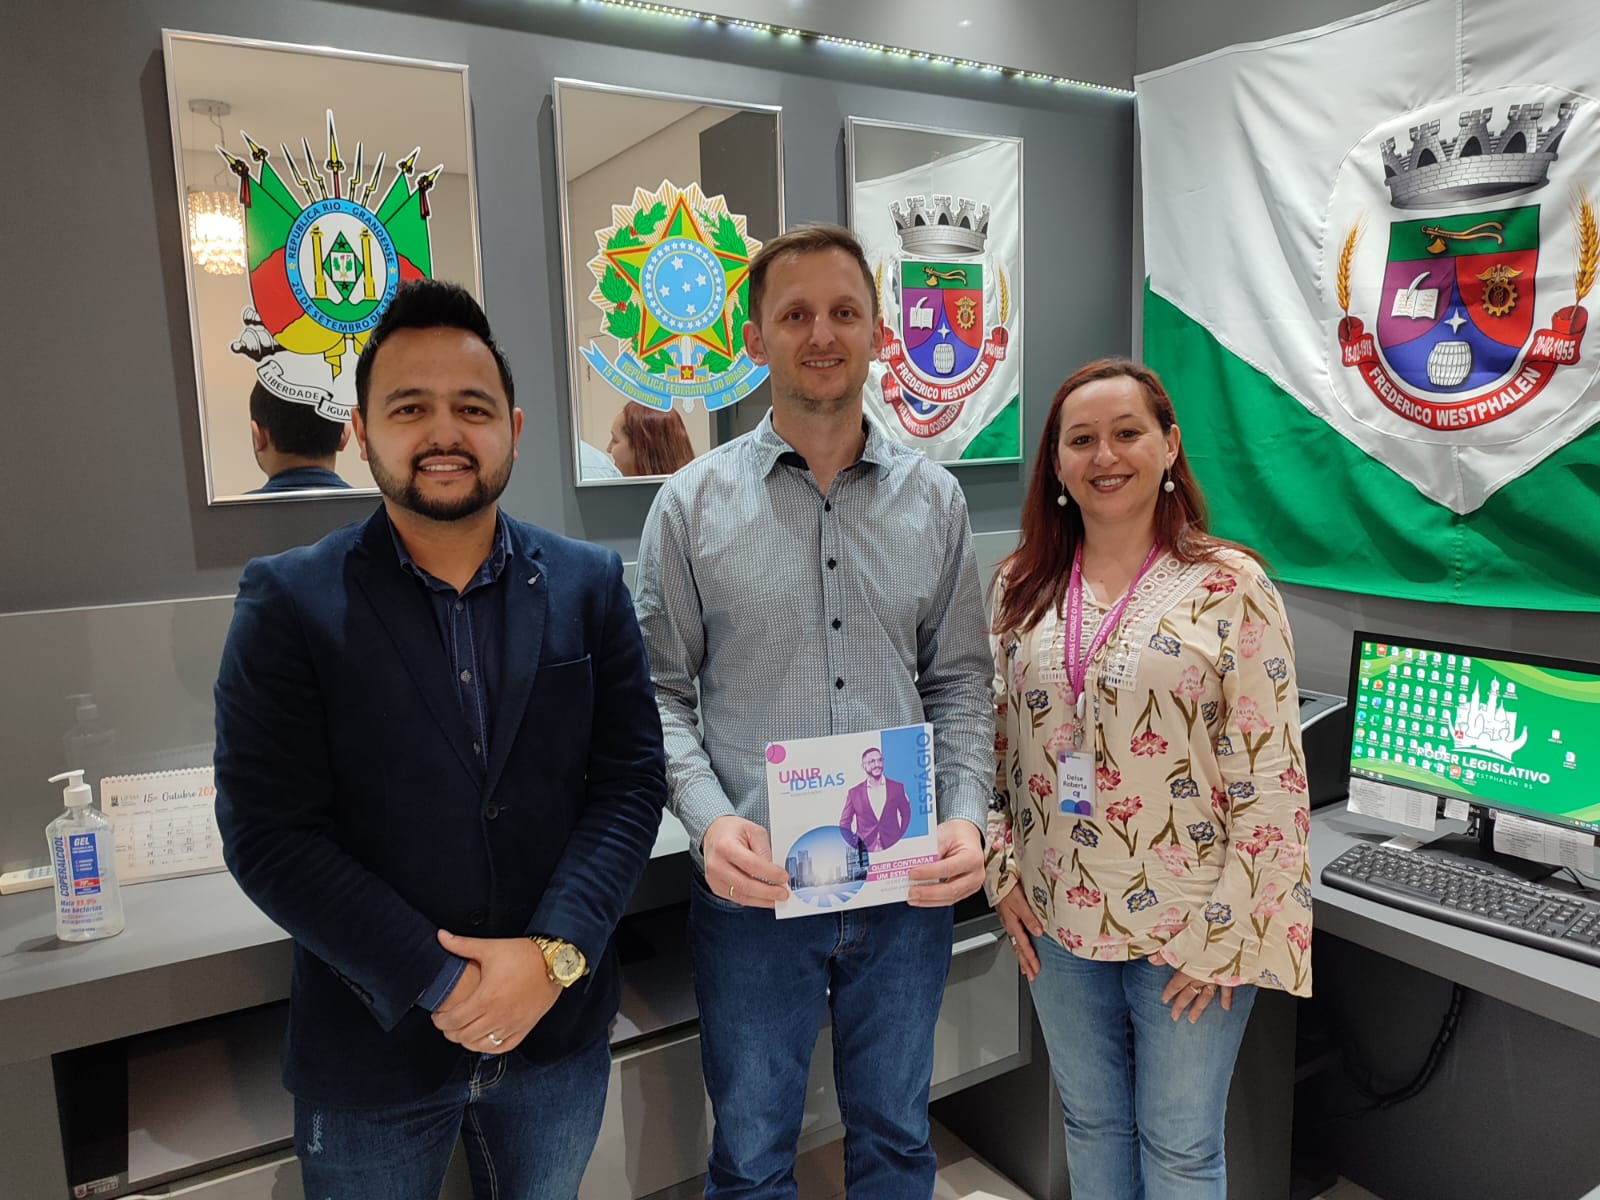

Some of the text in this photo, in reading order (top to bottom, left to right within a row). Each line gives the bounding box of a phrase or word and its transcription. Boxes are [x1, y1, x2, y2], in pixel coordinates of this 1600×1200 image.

[288, 202, 395, 264] REPUBLICA RIO GRANDENSE
[291, 281, 303, 296] 20
[300, 297, 312, 313] DE
[311, 310, 370, 332] SETEMBRO
[262, 370, 320, 401] LIBERDADE
[895, 361, 990, 401] FREDERICO WESTPHALEN
[1368, 366, 1542, 427] FREDERICO WESTPHALEN
[326, 404, 351, 417] IGUA
[778, 767, 821, 784] UNIR
[913, 731, 933, 817] ESTÁGIO
[1416, 746, 1460, 765] PODER
[1461, 756, 1551, 785] LEGISLATIVO
[197, 785, 214, 797] 202
[789, 772, 846, 792] IDEIAS
[1474, 772, 1519, 787] ESTPHALEN
[74, 836, 90, 847] GEL
[54, 836, 70, 897] COPERALCOOL
[871, 856, 934, 872] QUER CONTRATAR
[876, 873, 889, 881] UM
